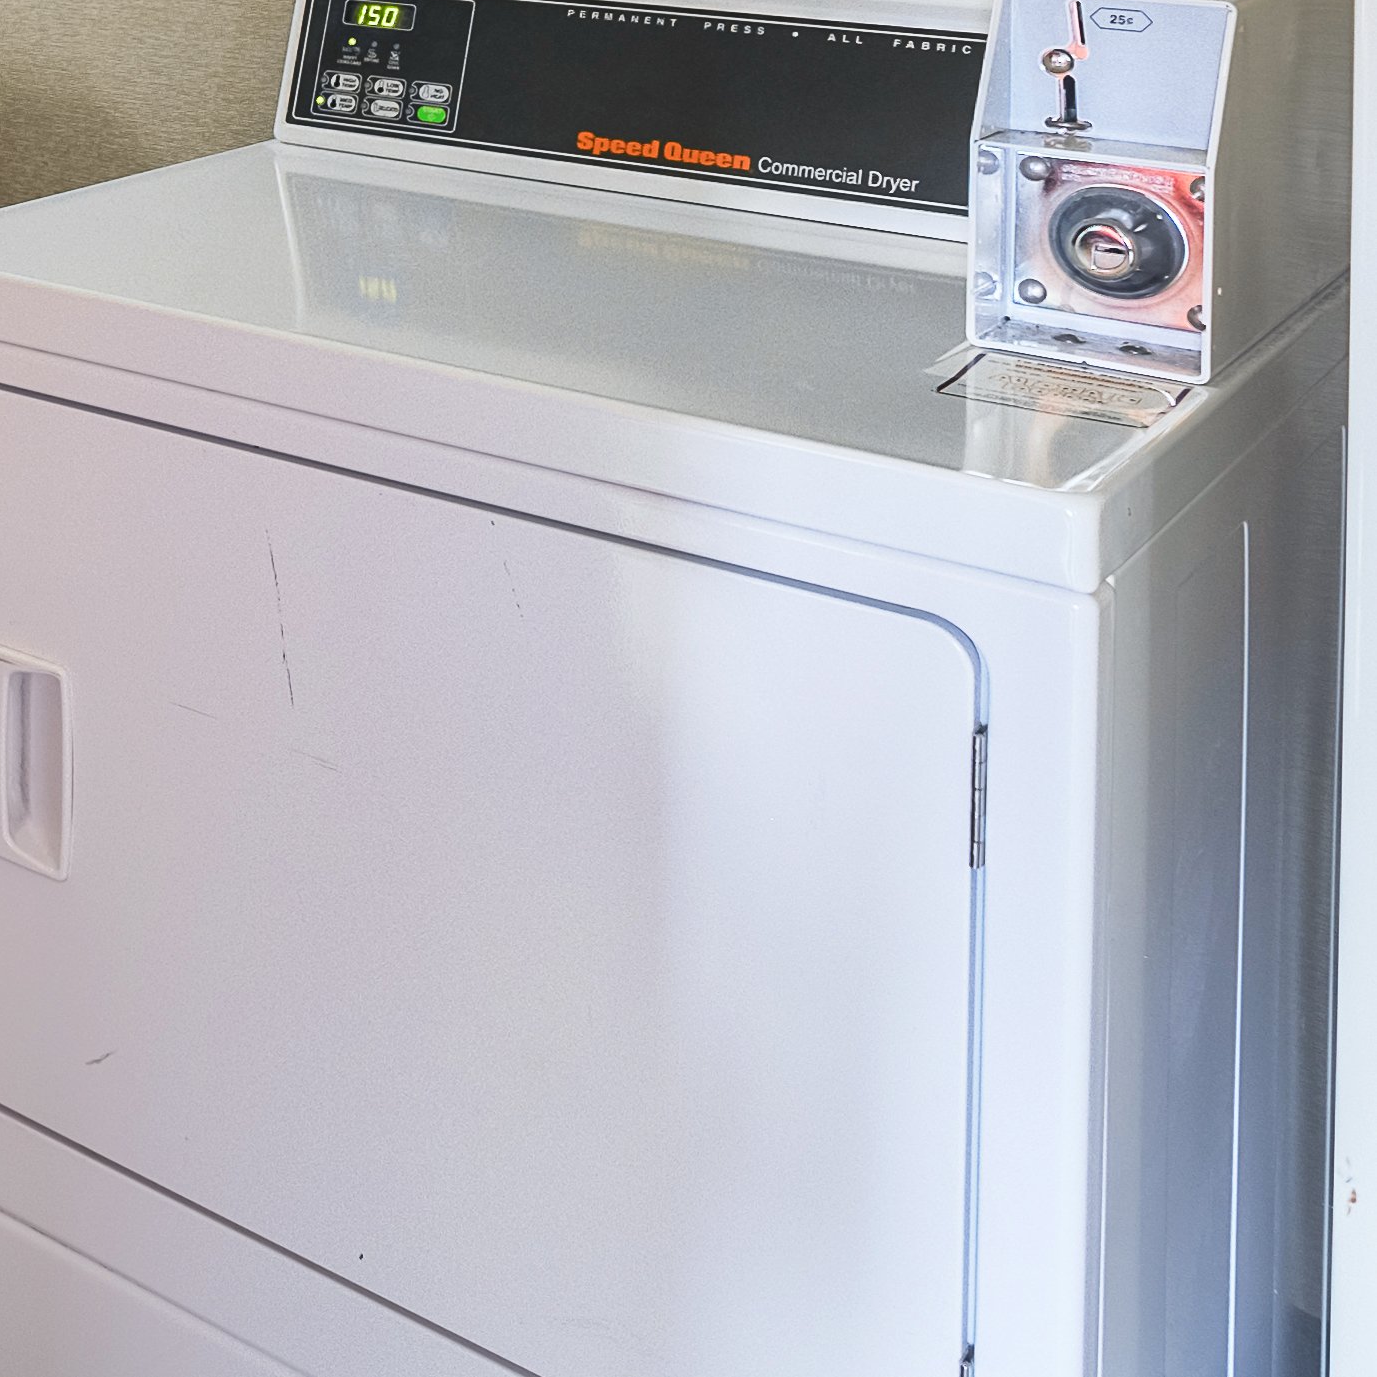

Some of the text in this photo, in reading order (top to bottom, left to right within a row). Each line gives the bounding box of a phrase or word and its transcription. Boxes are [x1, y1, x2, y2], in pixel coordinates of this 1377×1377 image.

[357, 5, 400, 27] 150
[567, 9, 765, 35] PERMANENT PRESS
[827, 33, 864, 45] ALL
[576, 130, 920, 194] Speed Queen Commercial Dryer
